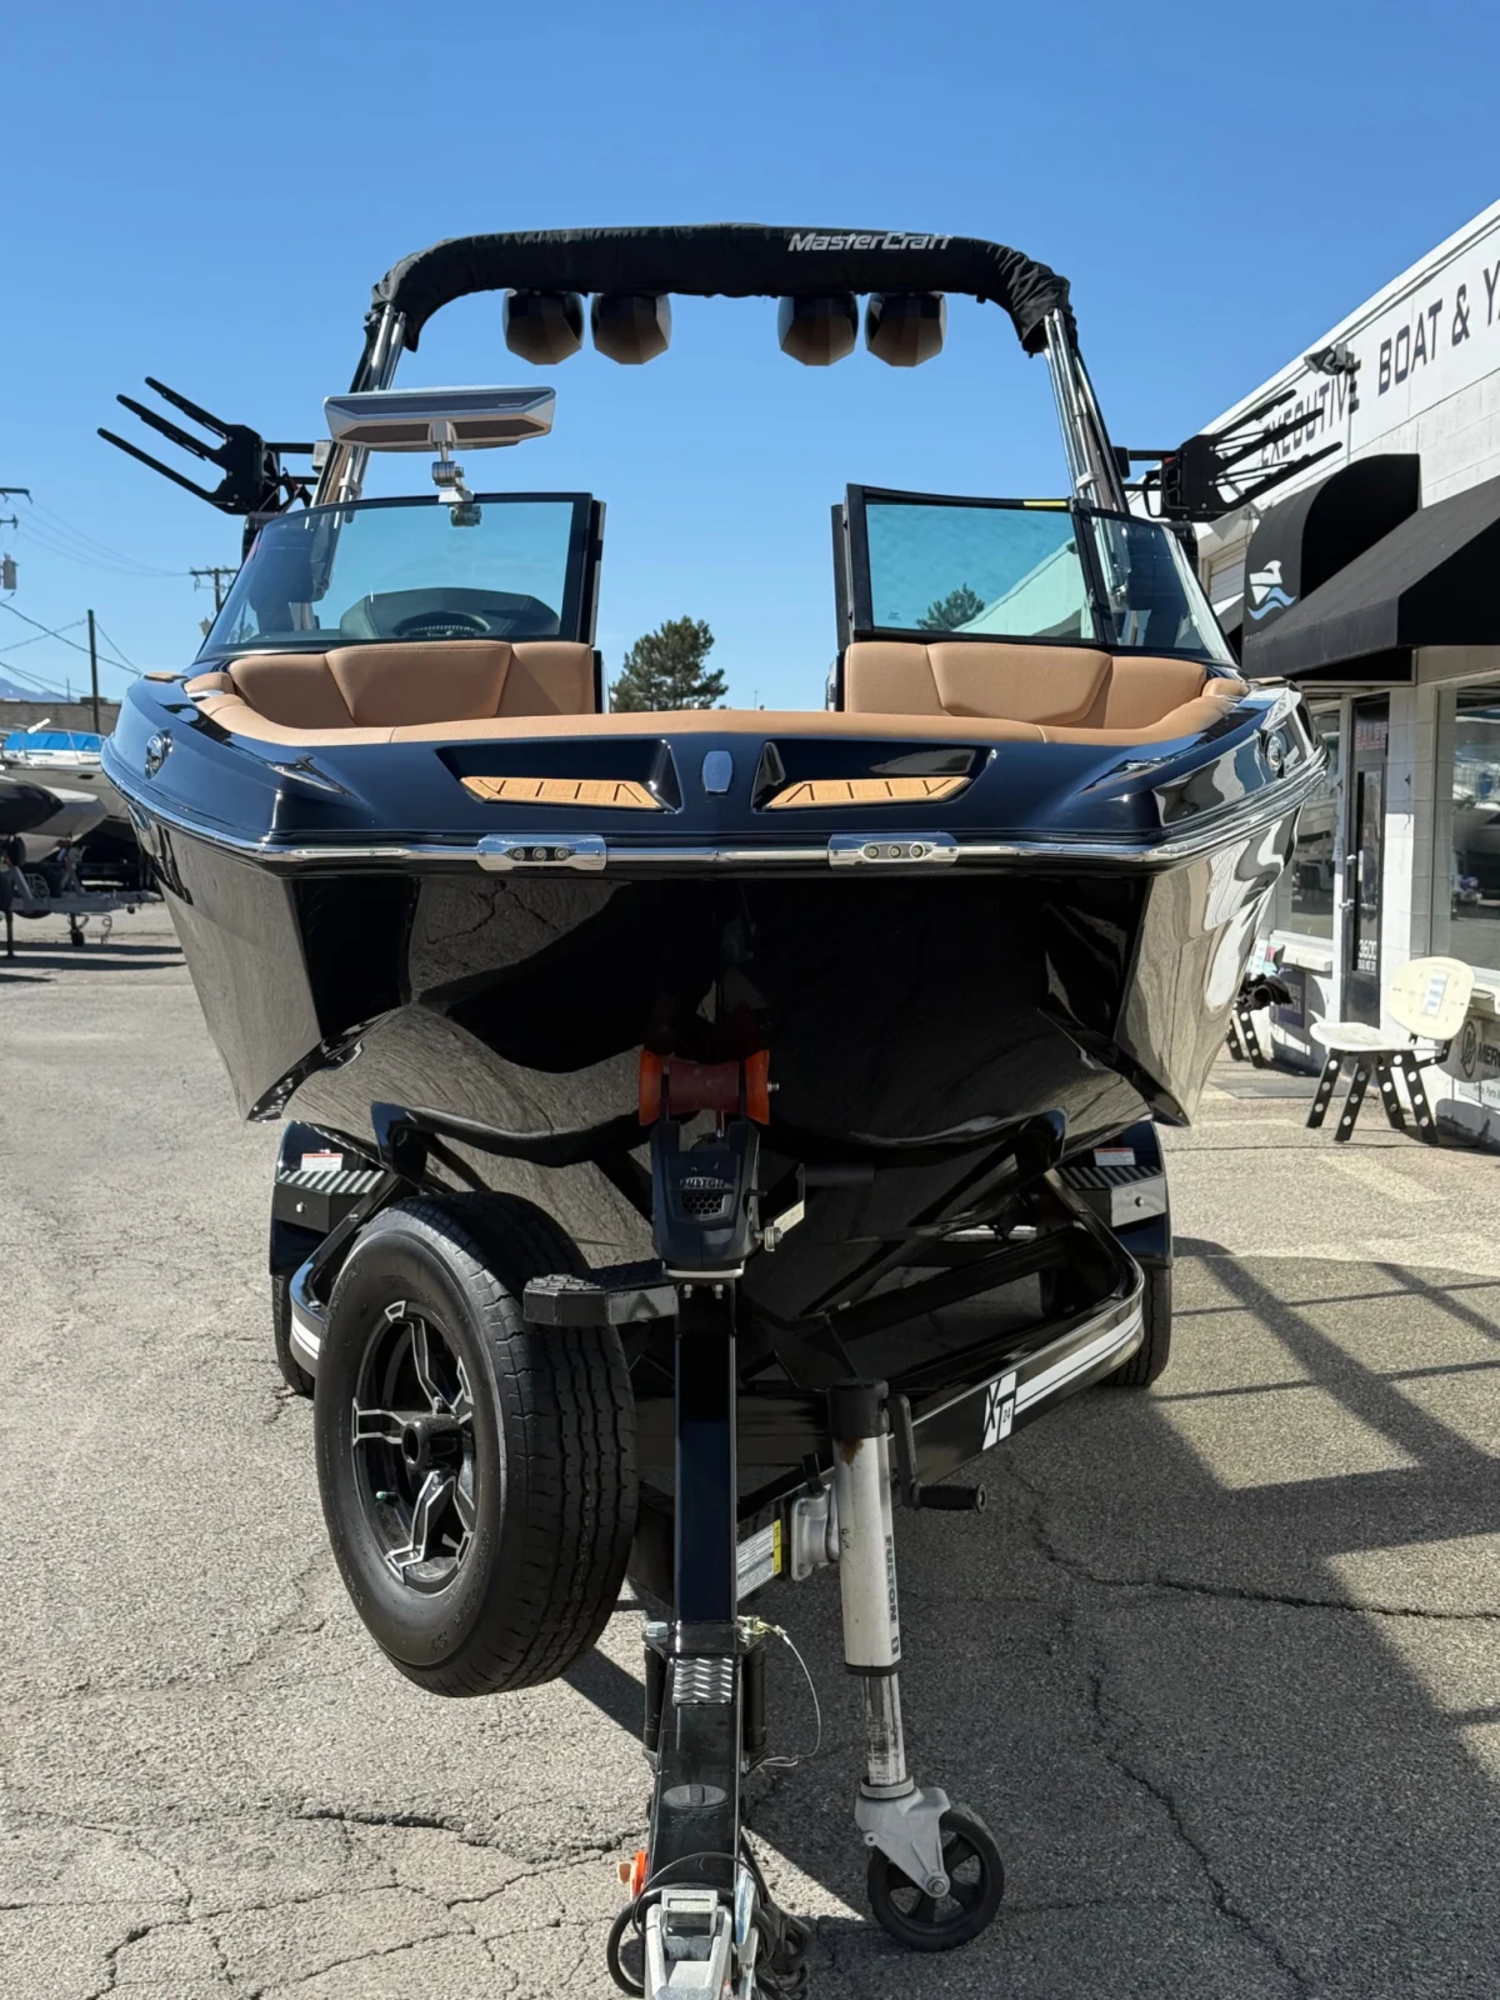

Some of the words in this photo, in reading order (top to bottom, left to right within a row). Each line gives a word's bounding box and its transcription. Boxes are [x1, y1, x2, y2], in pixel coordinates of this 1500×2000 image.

[788, 232, 952, 251] MasterCraft
[1379, 298, 1443, 396] BOAT
[1452, 284, 1470, 347] &
[1483, 259, 1500, 327] Y
[1478, 1042, 1500, 1069] MER
[885, 1535, 897, 1622] FULTON
